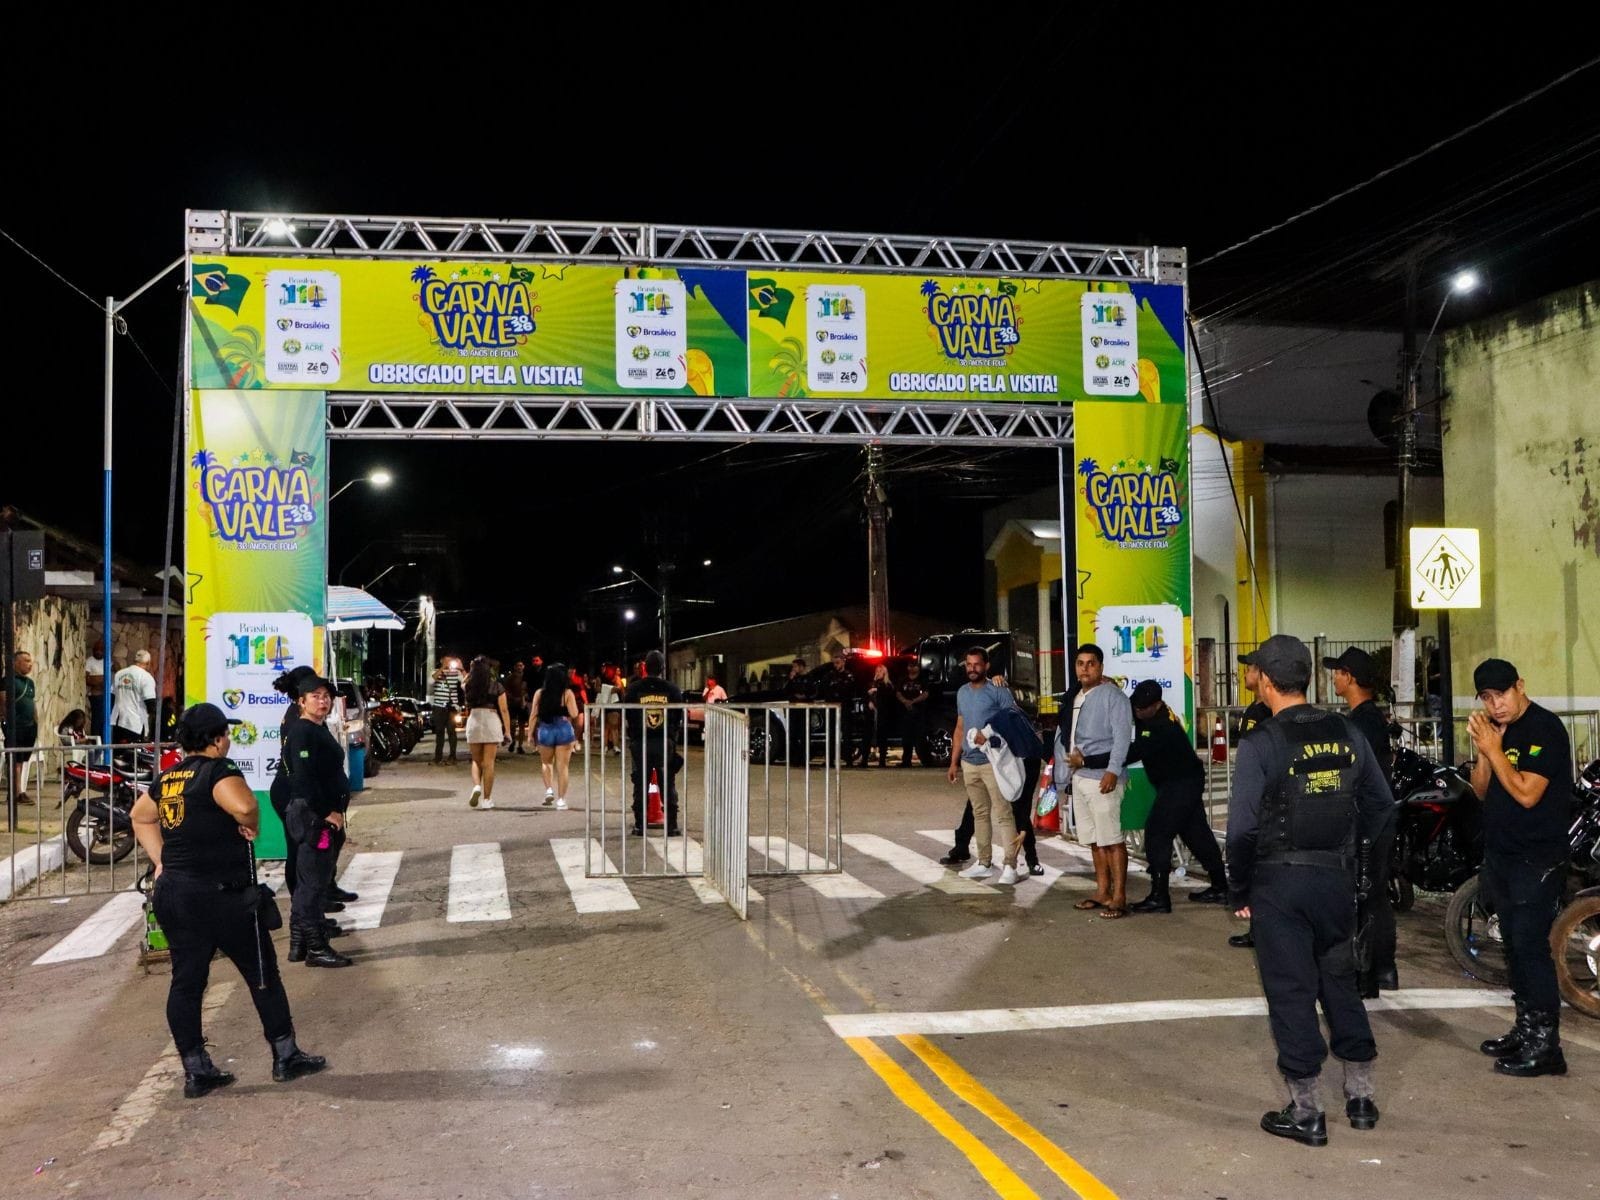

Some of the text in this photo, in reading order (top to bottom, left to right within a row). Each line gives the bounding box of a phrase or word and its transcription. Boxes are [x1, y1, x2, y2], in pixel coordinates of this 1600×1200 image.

[424, 281, 531, 316] CARNA
[930, 294, 1016, 327] CARNA
[294, 320, 330, 330] Brasiléia
[437, 314, 518, 347] VALE
[643, 327, 677, 337] Brasiléia
[944, 325, 1004, 355] VALE
[470, 349, 488, 357] ANOS
[489, 349, 498, 357] DE
[369, 363, 584, 386] OBRIGADO PELA VISITA!
[889, 372, 1058, 393] OBRIGADO PELA VISITA!
[205, 466, 311, 504] CARNA
[1090, 474, 1178, 507] CARNA
[217, 502, 297, 538] VALE
[1101, 505, 1168, 538] VALE
[269, 542, 278, 550] DE
